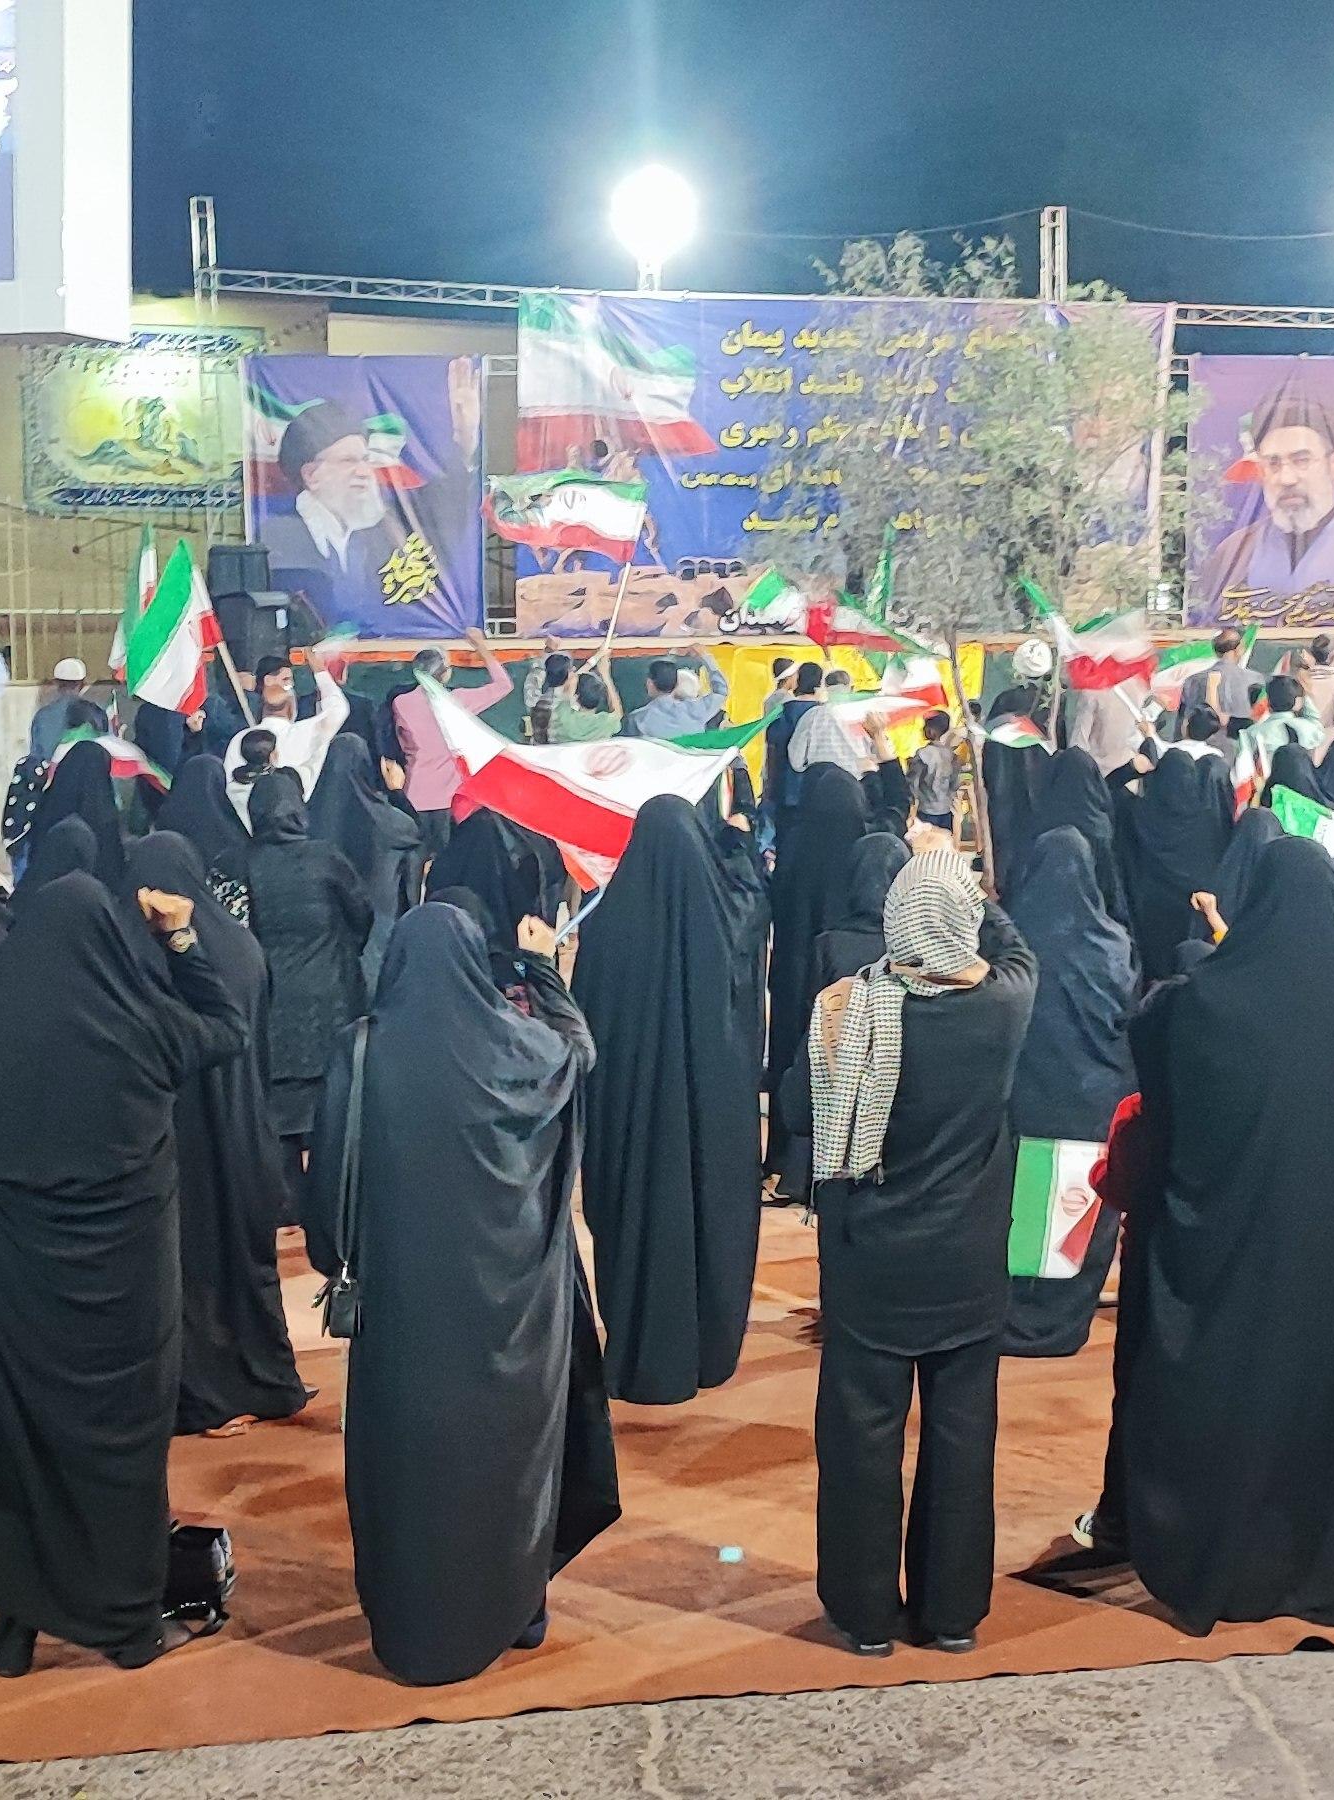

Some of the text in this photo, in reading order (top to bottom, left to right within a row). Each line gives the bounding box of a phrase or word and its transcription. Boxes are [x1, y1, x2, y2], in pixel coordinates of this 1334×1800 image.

[720, 320, 785, 359] پیمان
[719, 366, 793, 400] انقلاب
[719, 421, 799, 448] رهبری
